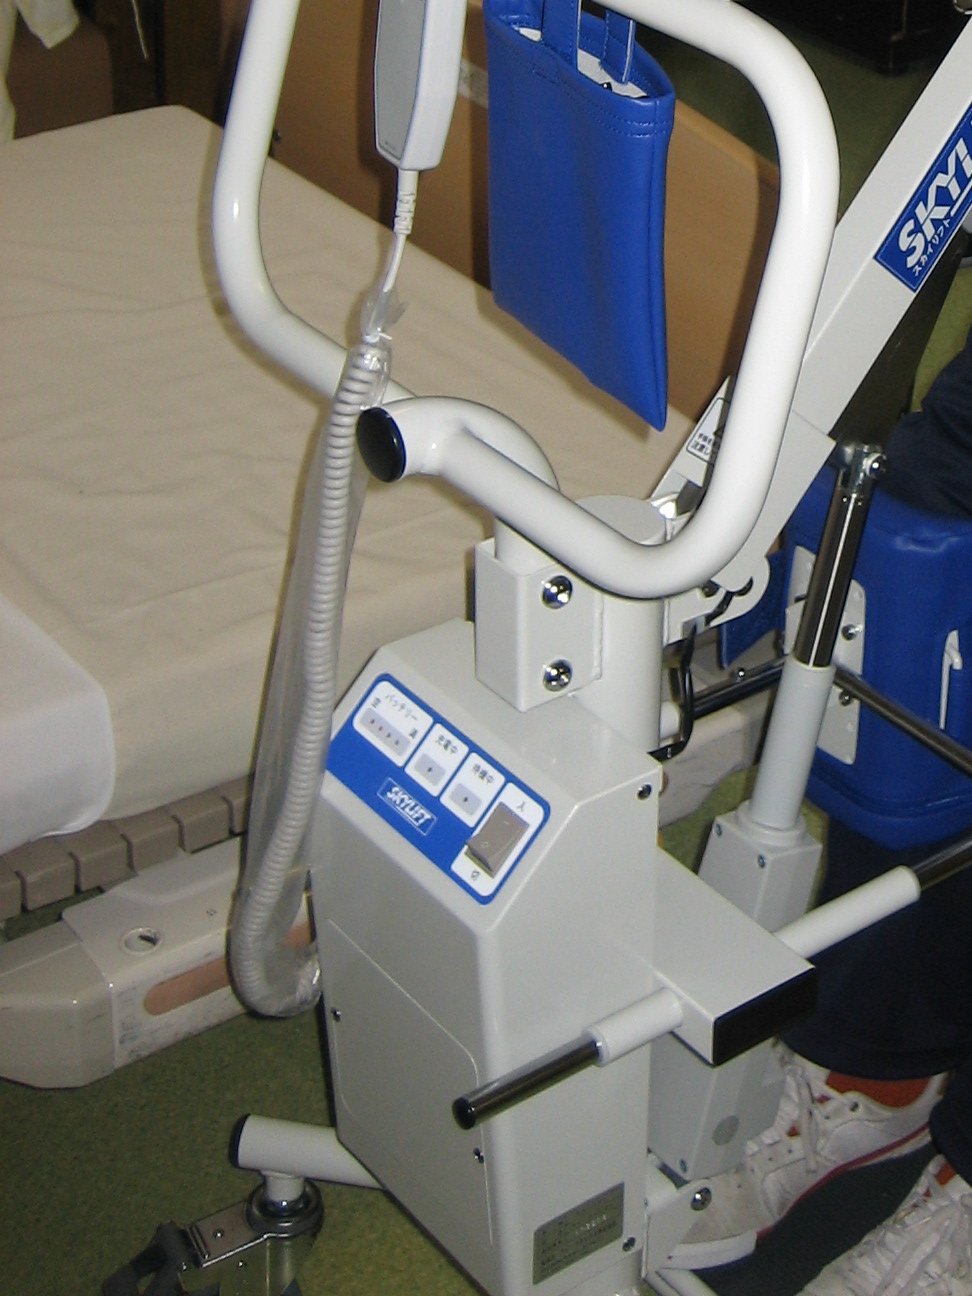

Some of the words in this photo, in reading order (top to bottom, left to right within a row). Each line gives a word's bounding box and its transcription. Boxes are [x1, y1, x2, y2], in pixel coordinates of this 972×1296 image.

[912, 217, 951, 278] スカイリフト
[385, 785, 434, 828] SKYLIFT
